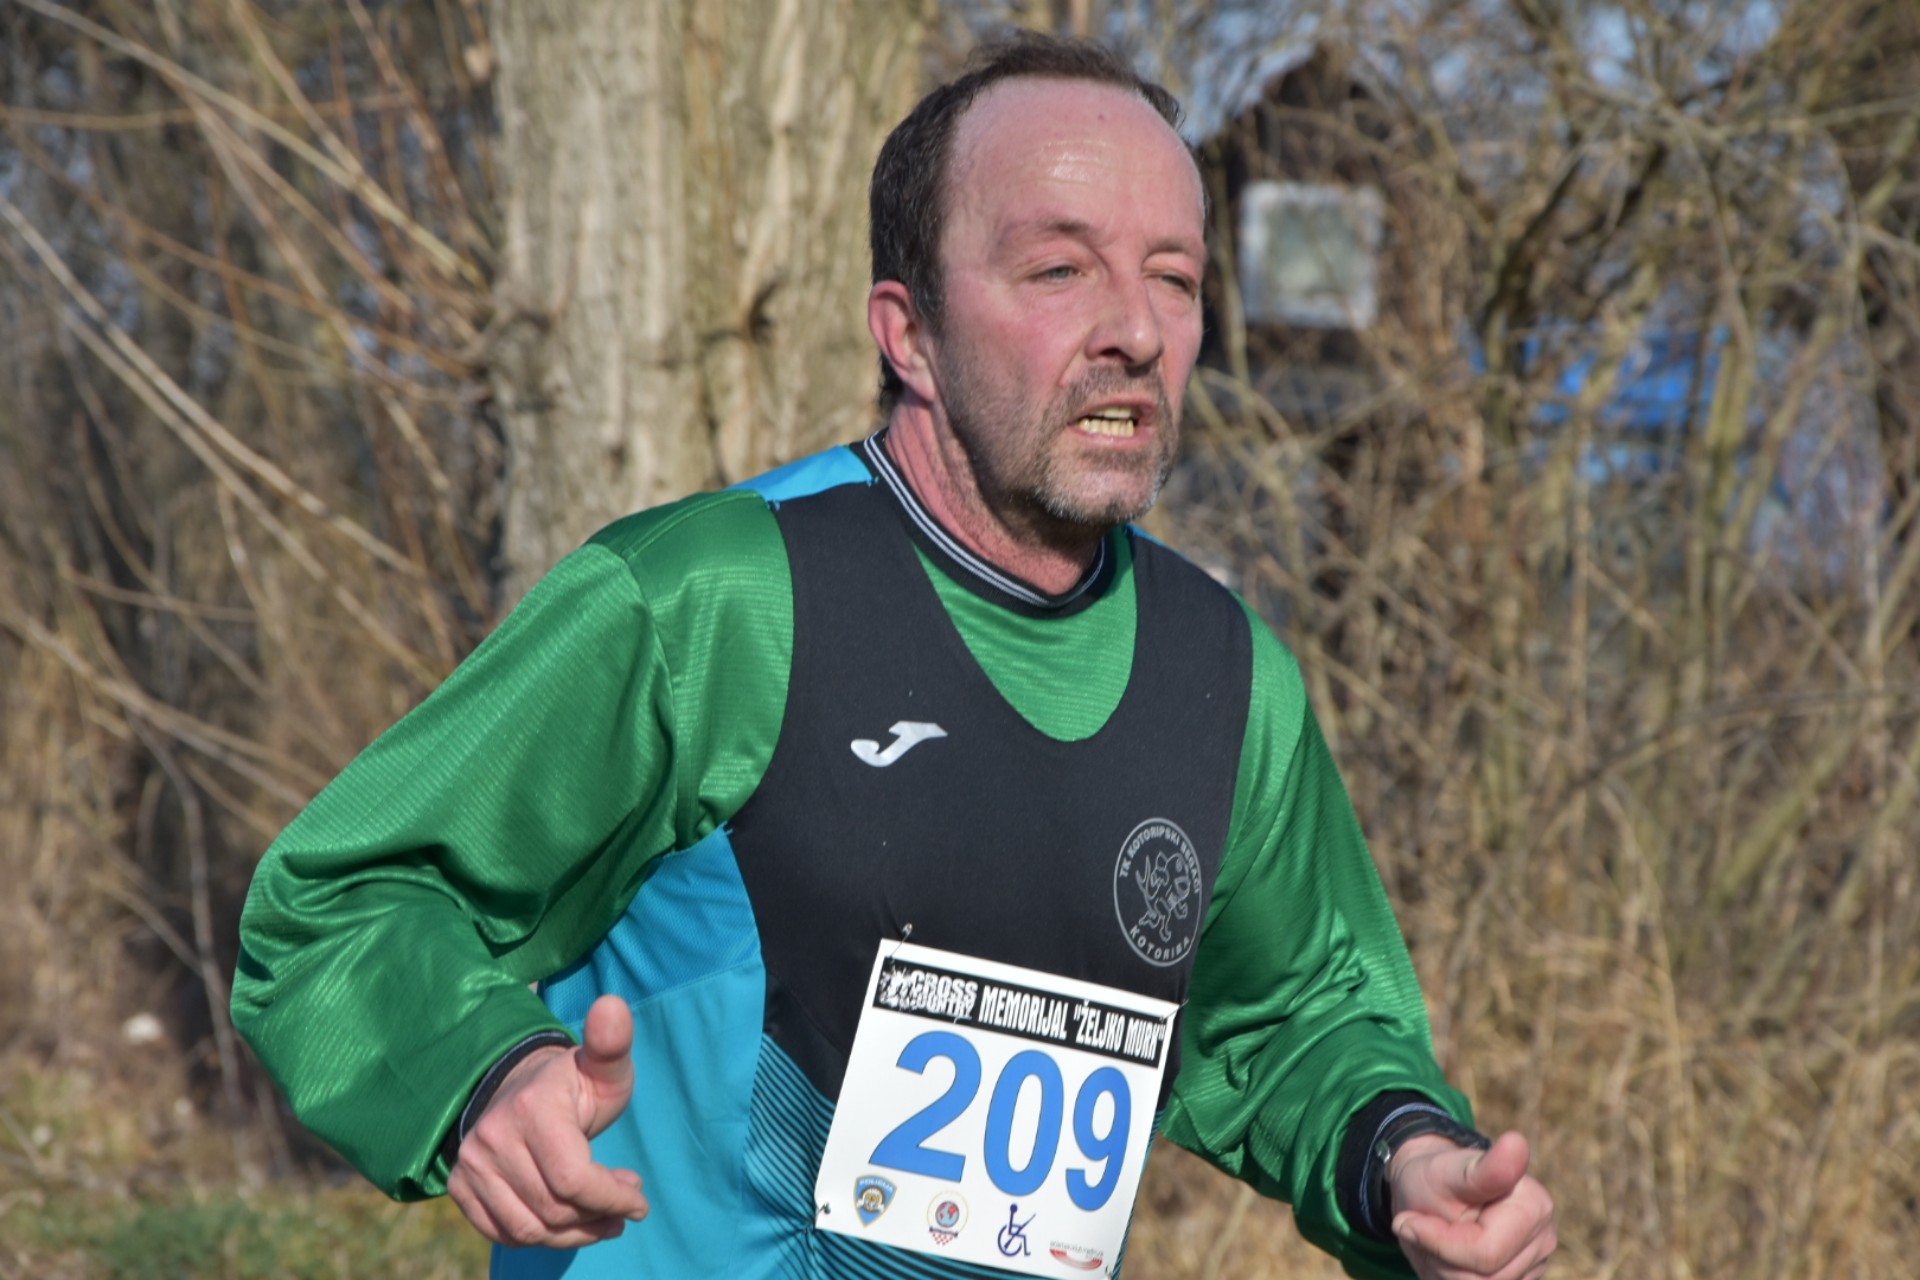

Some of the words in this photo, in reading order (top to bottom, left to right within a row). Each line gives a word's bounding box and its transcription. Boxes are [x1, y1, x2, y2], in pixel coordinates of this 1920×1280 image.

[1126, 825, 1181, 859] KOTORIPSKI
[1129, 924, 1190, 960] KOTORIBA
[910, 970, 979, 1003] CROSS
[978, 985, 1069, 1040] MEMORIJAL
[868, 1030, 1132, 1212] 209
